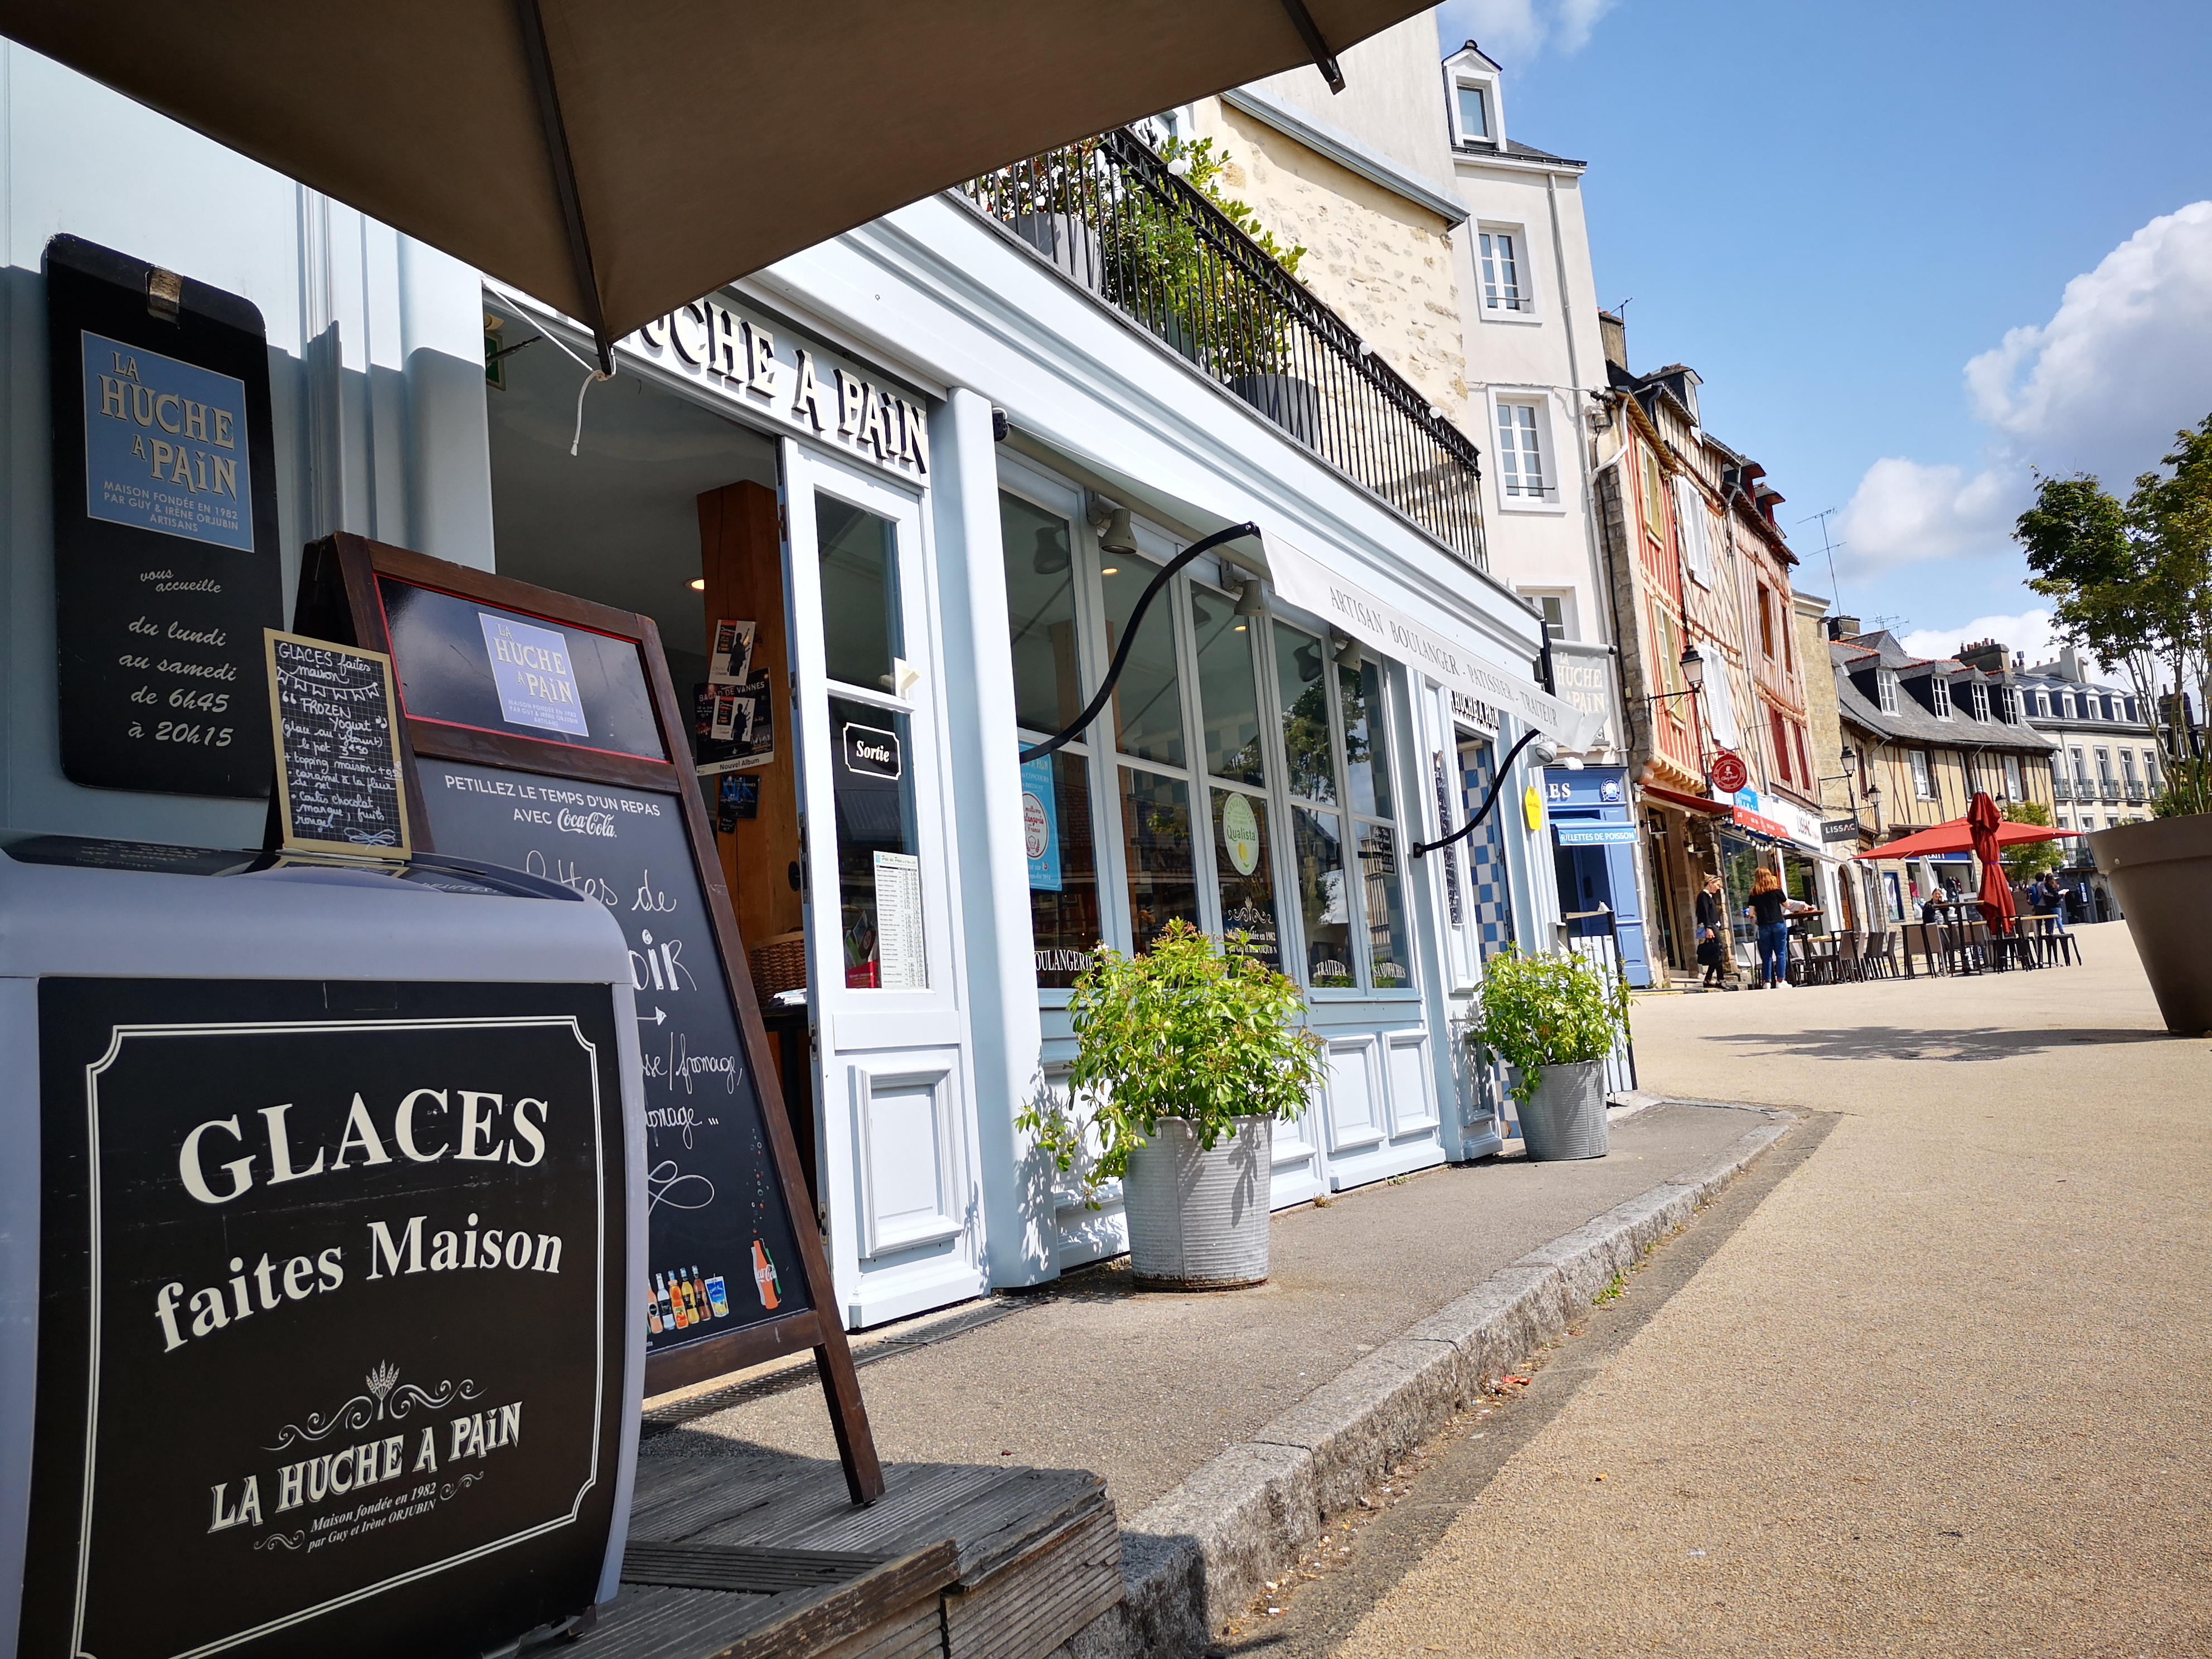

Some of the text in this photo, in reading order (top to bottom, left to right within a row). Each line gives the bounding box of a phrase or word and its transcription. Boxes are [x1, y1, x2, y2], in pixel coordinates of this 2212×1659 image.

[112, 351, 140, 383] LA
[637, 298, 776, 399] UCHE
[792, 348, 827, 432] A
[98, 374, 234, 450] HUCHE
[130, 434, 147, 461] A
[104, 481, 238, 520] MAISON FONDÉE EN 1982
[104, 492, 238, 531] PAR GUY & IRÈNE ORJUBIN
[149, 513, 198, 532] ARTISANS
[140, 569, 174, 583] vous
[155, 578, 222, 594] accueille
[128, 615, 227, 647] du lundi
[496, 623, 512, 639] LA
[279, 642, 371, 676] GLACES faites
[493, 637, 567, 676] HUCHE
[1329, 585, 1559, 727] ARTISAN BOULANGER PATISSIER TRAITEUR
[1559, 652, 1569, 666] LA
[118, 654, 237, 682] au samedi
[289, 664, 350, 684] maison
[517, 671, 525, 685] A
[1555, 666, 1603, 688] HUCHE
[130, 685, 230, 712] de 6h45
[725, 688, 734, 696] DE
[736, 681, 765, 694] VANNES
[508, 698, 532, 710] MAISON
[127, 720, 234, 747] à 20h15
[314, 727, 334, 738] au
[297, 738, 310, 749] le
[313, 741, 331, 756] pot
[856, 740, 890, 763] Sortie
[294, 751, 329, 775] topping
[334, 760, 377, 774] maison
[719, 758, 760, 770] Nouvel Album
[444, 775, 661, 817] PETILLEZ LE TEMPS D'UN REPAS
[513, 808, 553, 826] AVEC
[1826, 823, 1855, 834] LISSAC
[1227, 825, 1255, 842] Qualista
[1561, 831, 1635, 842] RILLETTES DE POISSON
[631, 869, 677, 912] de
[1266, 932, 1276, 941] 1982
[1035, 949, 1094, 971] OULANGERIE
[1316, 959, 1406, 978] TRAITEUR SANDWICHES
[178, 1088, 549, 1205] GLACES
[154, 1212, 564, 1353] faites Maison
[207, 1474, 263, 1534] LA
[275, 1434, 405, 1514] HUCHE
[413, 1426, 438, 1473] A
[310, 1482, 436, 1533] Maison fondée en 1982
[308, 1498, 436, 1553] par Guy et Irène ORJUBIN
